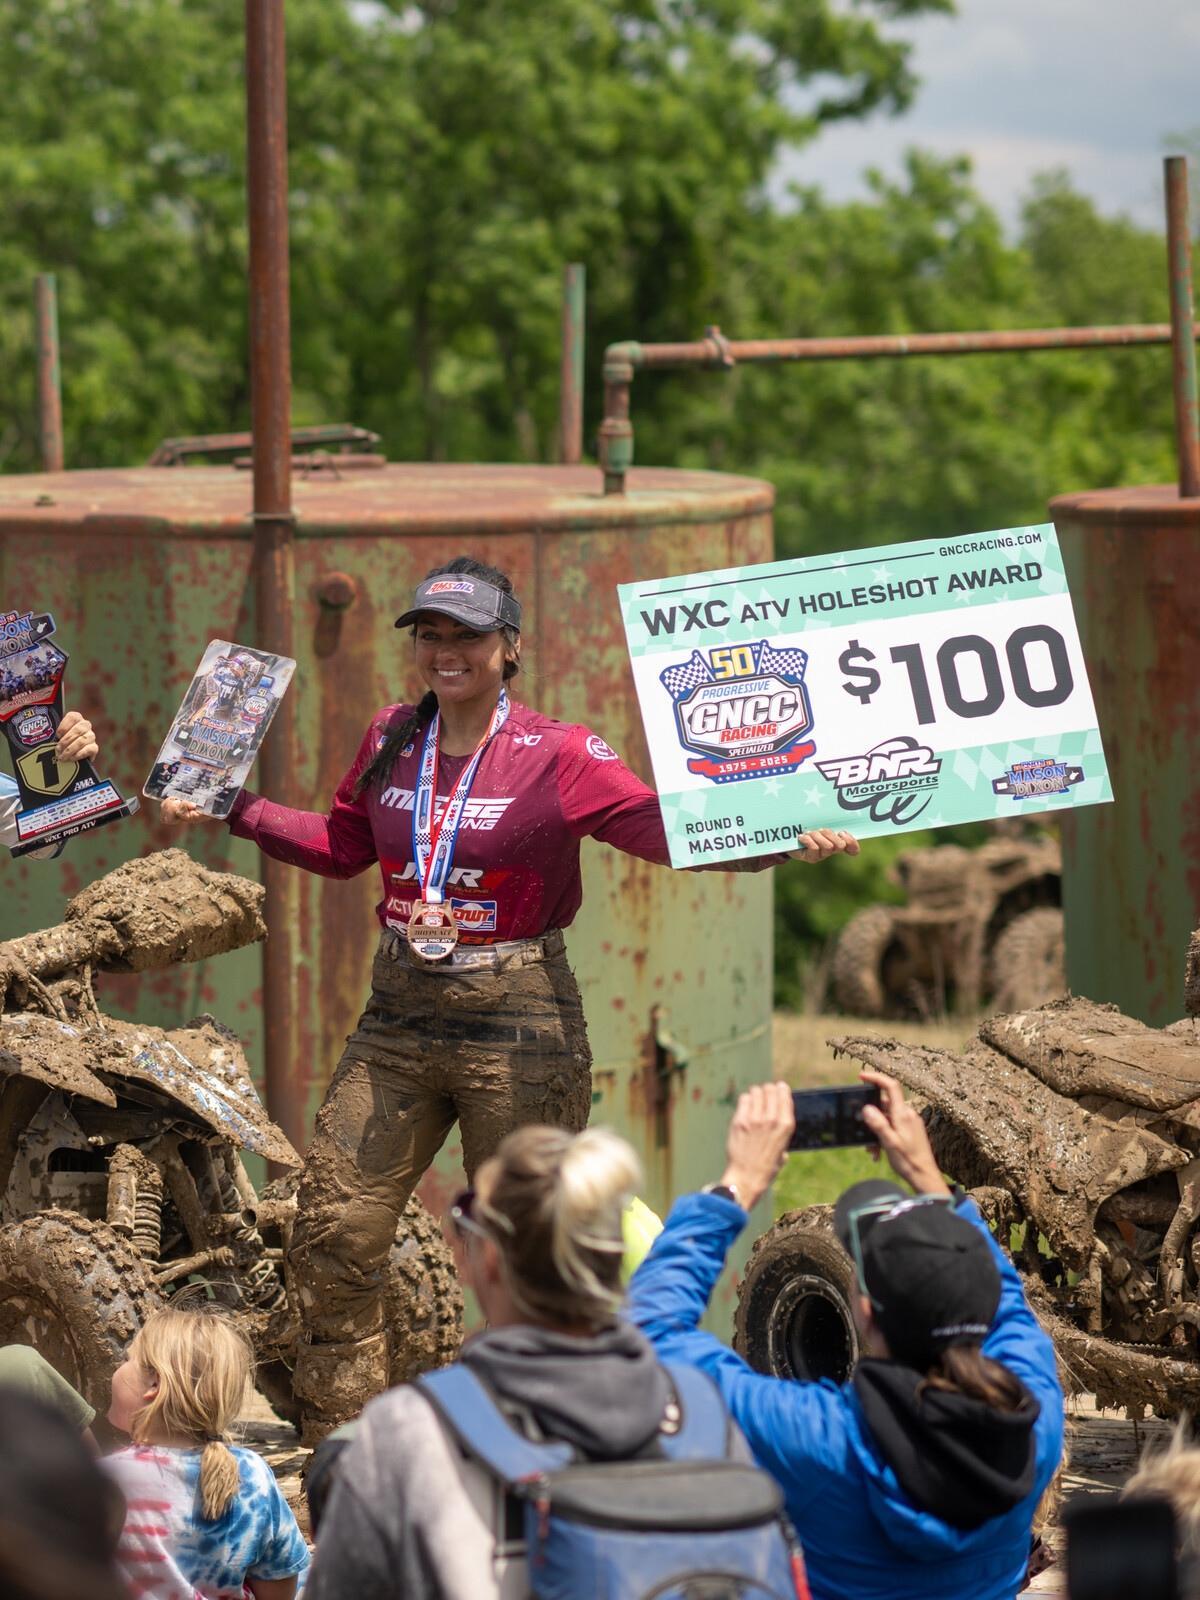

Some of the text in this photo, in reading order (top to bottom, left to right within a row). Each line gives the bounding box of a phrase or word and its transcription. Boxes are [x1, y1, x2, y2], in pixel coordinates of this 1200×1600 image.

[939, 533, 1042, 557] GNCCRACING.COM
[426, 582, 473, 594] AMSOIL
[640, 561, 1043, 637] WXC ATV HOLESHOT AWARD
[838, 624, 1074, 725] $100
[701, 680, 771, 700] PROGRESSIVE
[690, 691, 797, 735] GNCC
[22, 718, 47, 733] GNCC
[720, 722, 777, 743] RACING
[191, 724, 238, 749] MASON
[188, 740, 228, 761] DIXON
[728, 743, 774, 757] SPECIALIZED
[425, 752, 434, 773] AMA
[719, 761, 747, 773] 1975
[760, 755, 788, 767] 2025
[816, 747, 941, 788] BNR
[73, 777, 95, 792] AMA
[1009, 764, 1066, 784] MASON
[846, 776, 939, 796] Motorsports
[1016, 778, 1066, 796] DIXON
[447, 804, 459, 826] AMA
[686, 815, 744, 834] ROUND 8
[44, 820, 97, 844] WXC PRO ATV
[688, 824, 803, 854] MASON-DIXON
